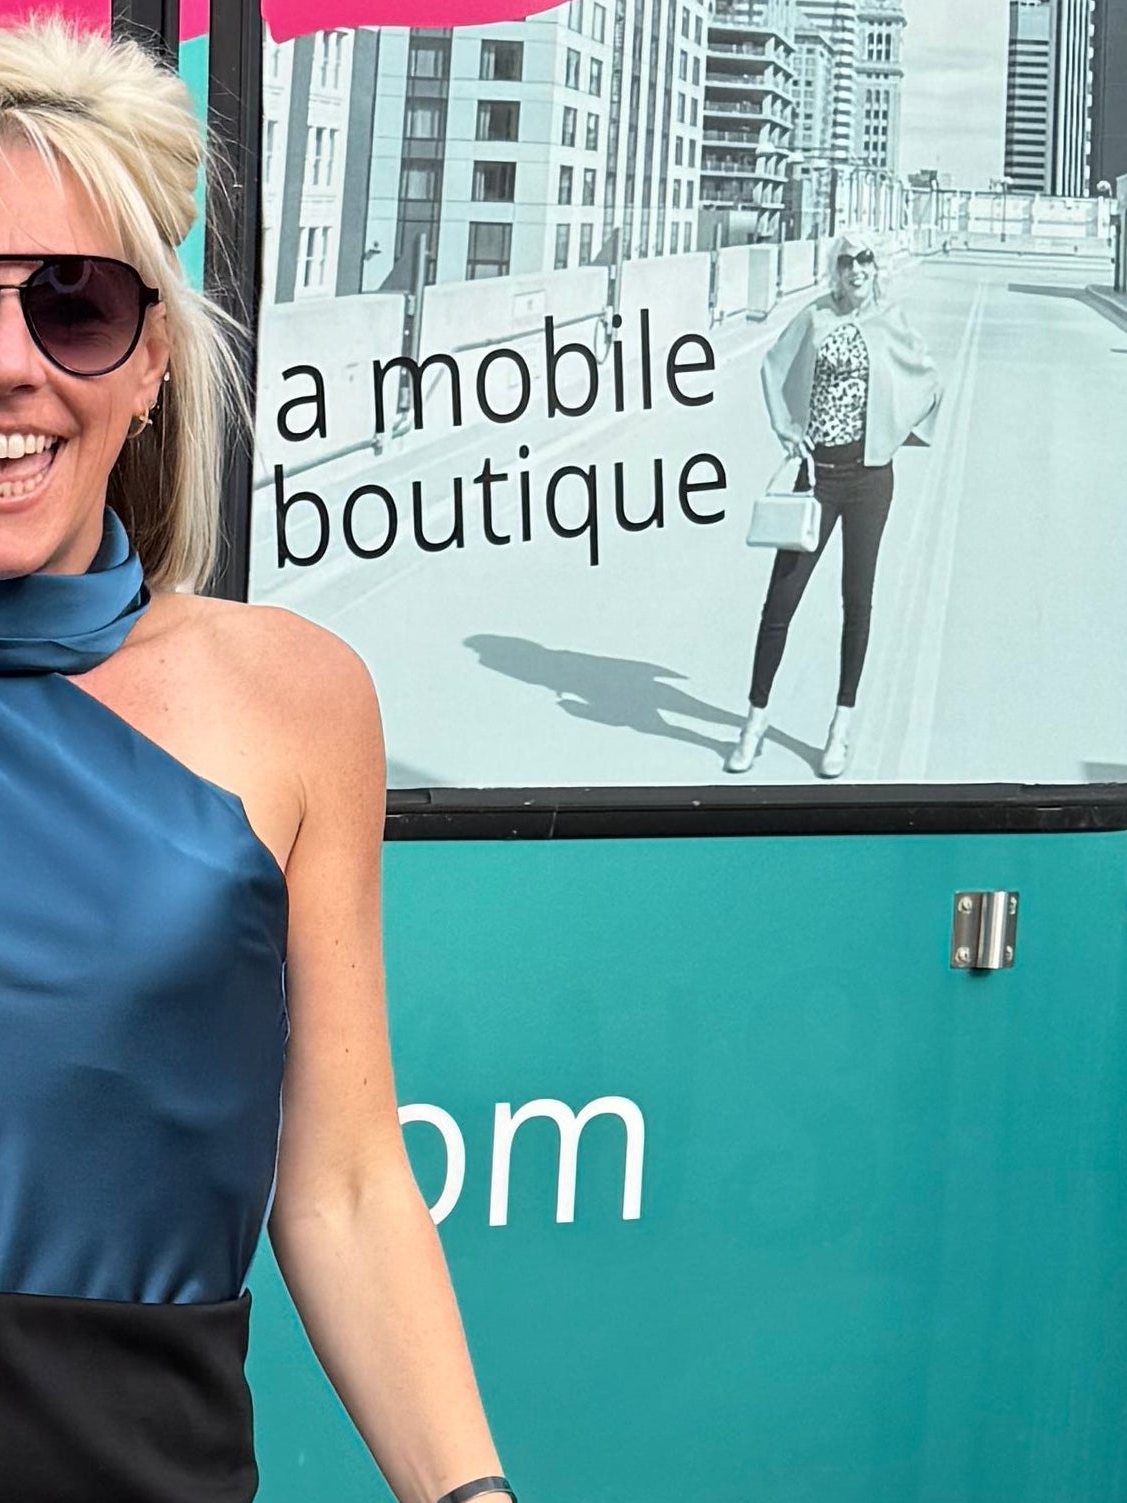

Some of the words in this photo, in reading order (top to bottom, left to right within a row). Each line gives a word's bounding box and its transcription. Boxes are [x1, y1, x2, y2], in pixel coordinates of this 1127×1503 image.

[277, 364, 327, 442] a
[373, 308, 715, 435] mobile
[274, 446, 727, 569] boutique
